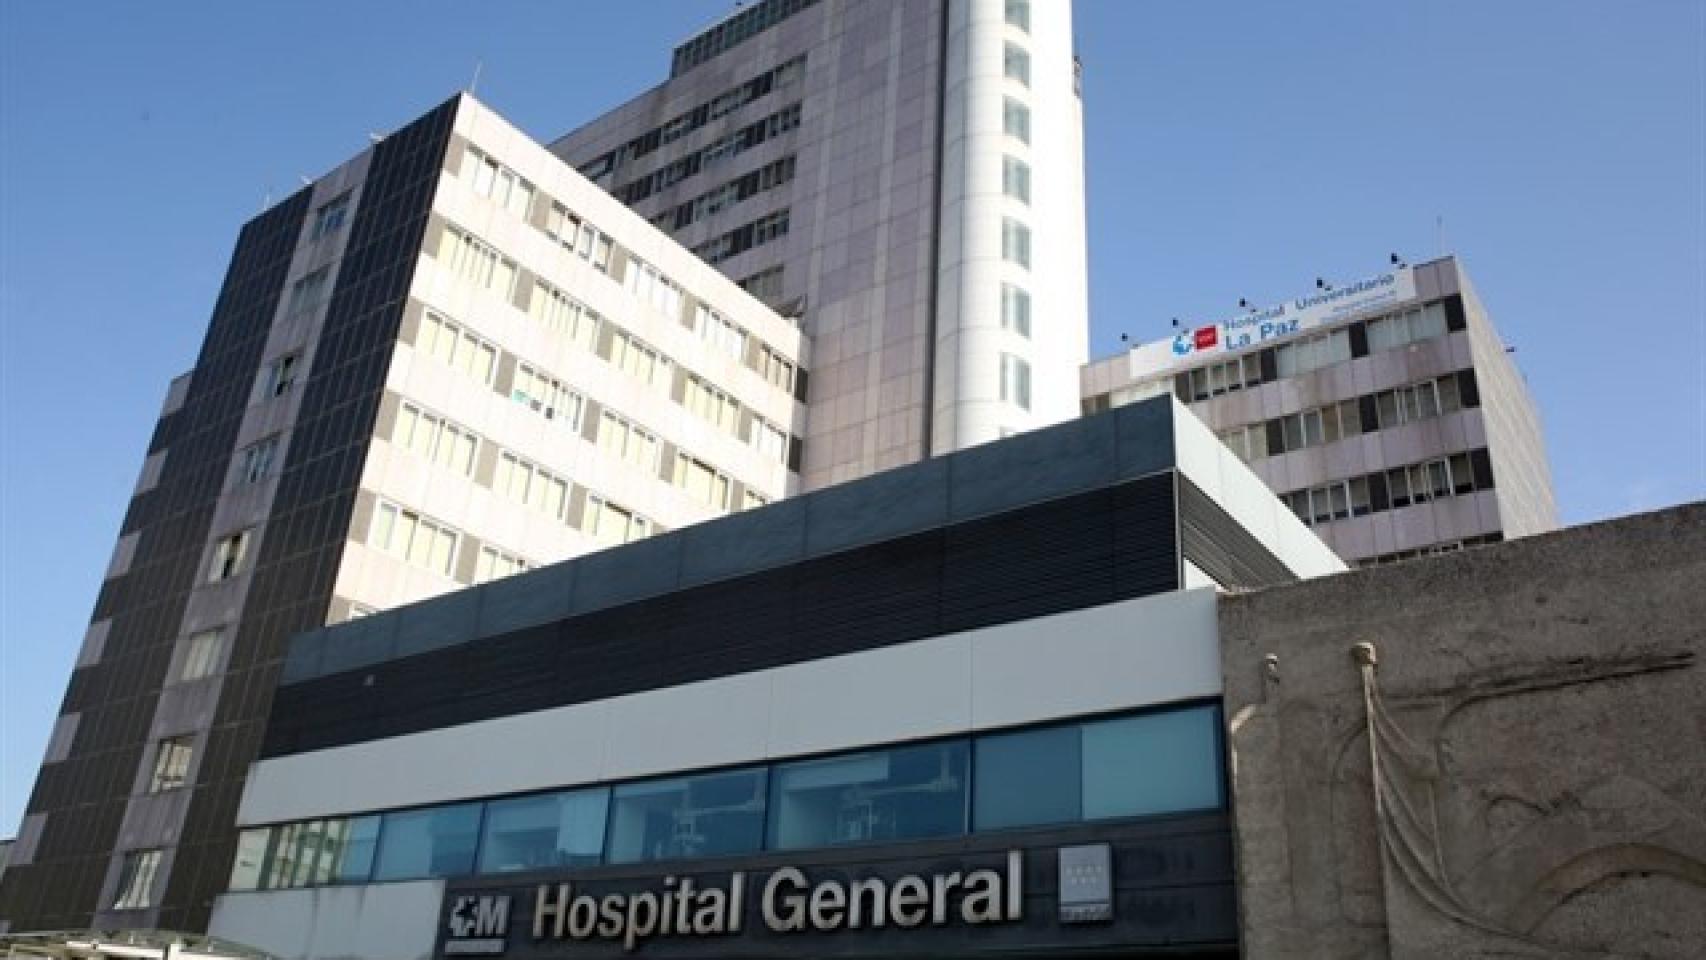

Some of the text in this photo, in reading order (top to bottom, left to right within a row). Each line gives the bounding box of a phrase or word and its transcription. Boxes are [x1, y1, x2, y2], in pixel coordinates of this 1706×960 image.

[1223, 303, 1286, 330] Hospital
[1295, 274, 1395, 310] Universitario
[1226, 332, 1251, 350] La
[1260, 319, 1299, 340] Paz
[532, 849, 1024, 950] Hospital General
